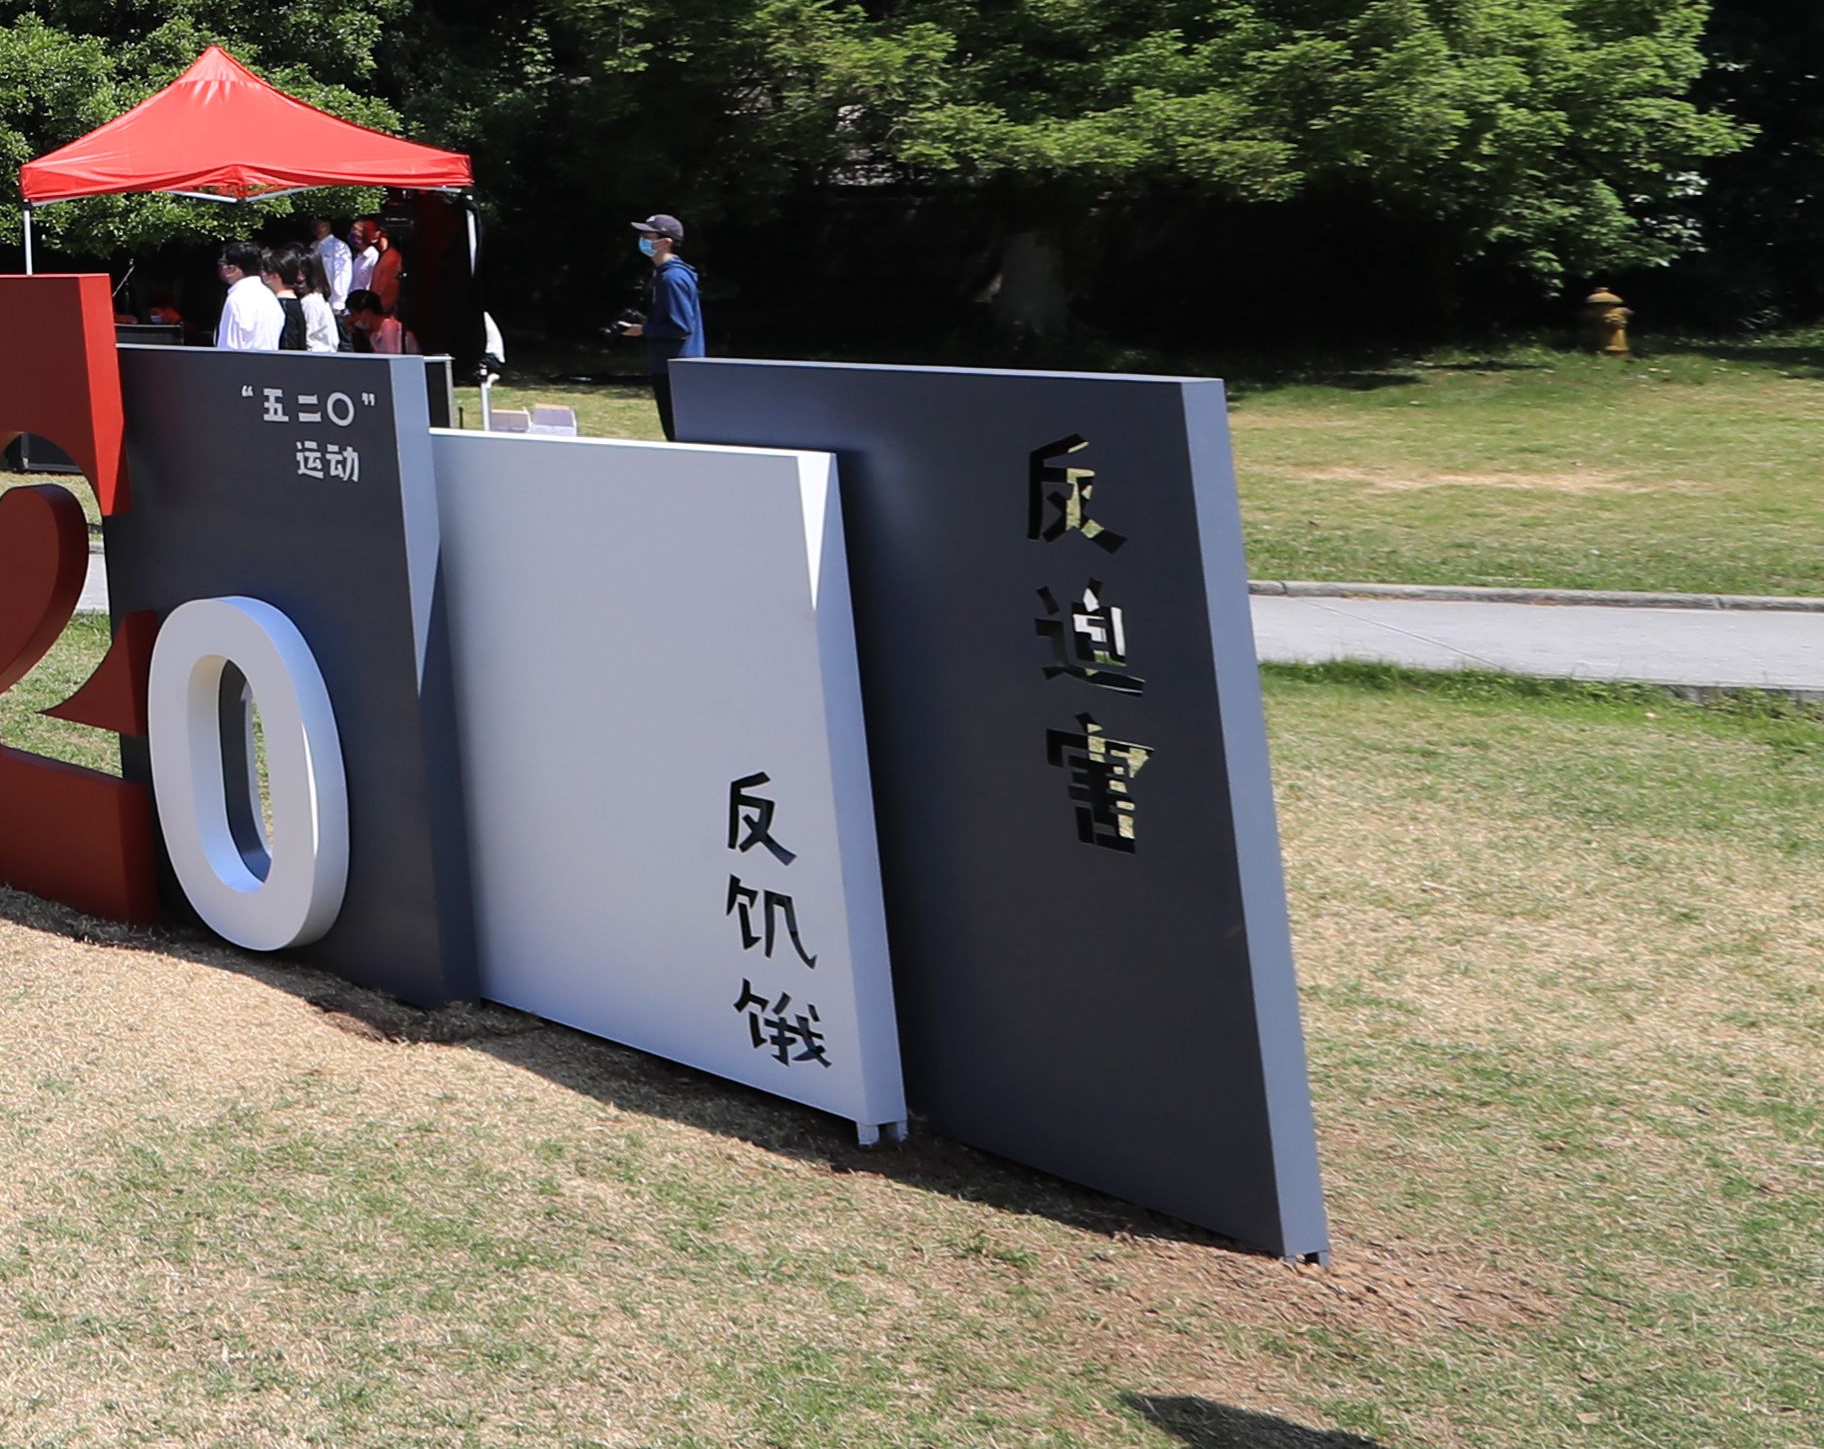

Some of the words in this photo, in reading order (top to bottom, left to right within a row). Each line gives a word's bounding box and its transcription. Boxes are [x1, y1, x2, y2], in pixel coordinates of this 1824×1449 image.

[296, 440, 359, 482] 运动
[1026, 433, 1155, 854] 反迫害
[726, 771, 832, 1068] 反饥饿
